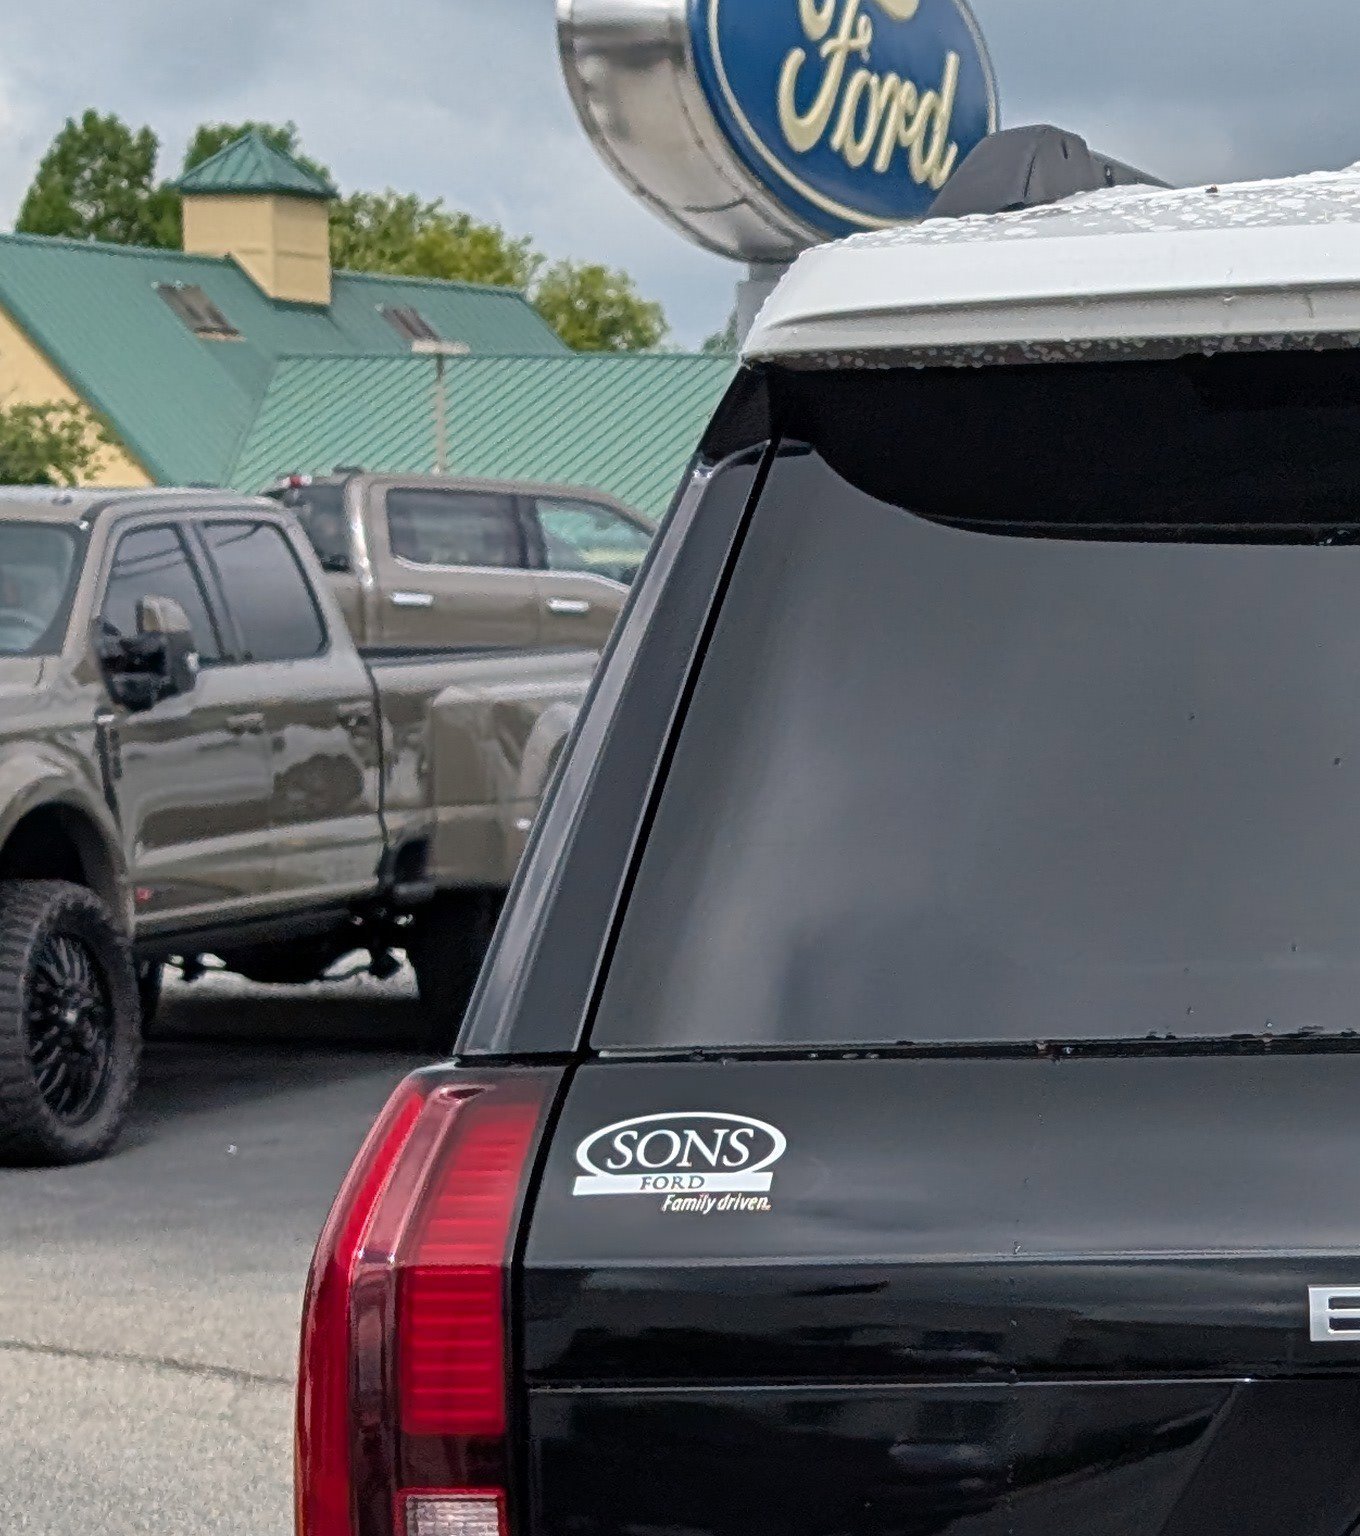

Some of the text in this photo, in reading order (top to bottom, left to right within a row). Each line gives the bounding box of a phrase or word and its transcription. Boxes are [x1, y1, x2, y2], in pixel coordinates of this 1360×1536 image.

[777, 0, 960, 190] Ford
[606, 1128, 754, 1169] SONS
[639, 1175, 705, 1190] FORD
[661, 1193, 716, 1215] Family
